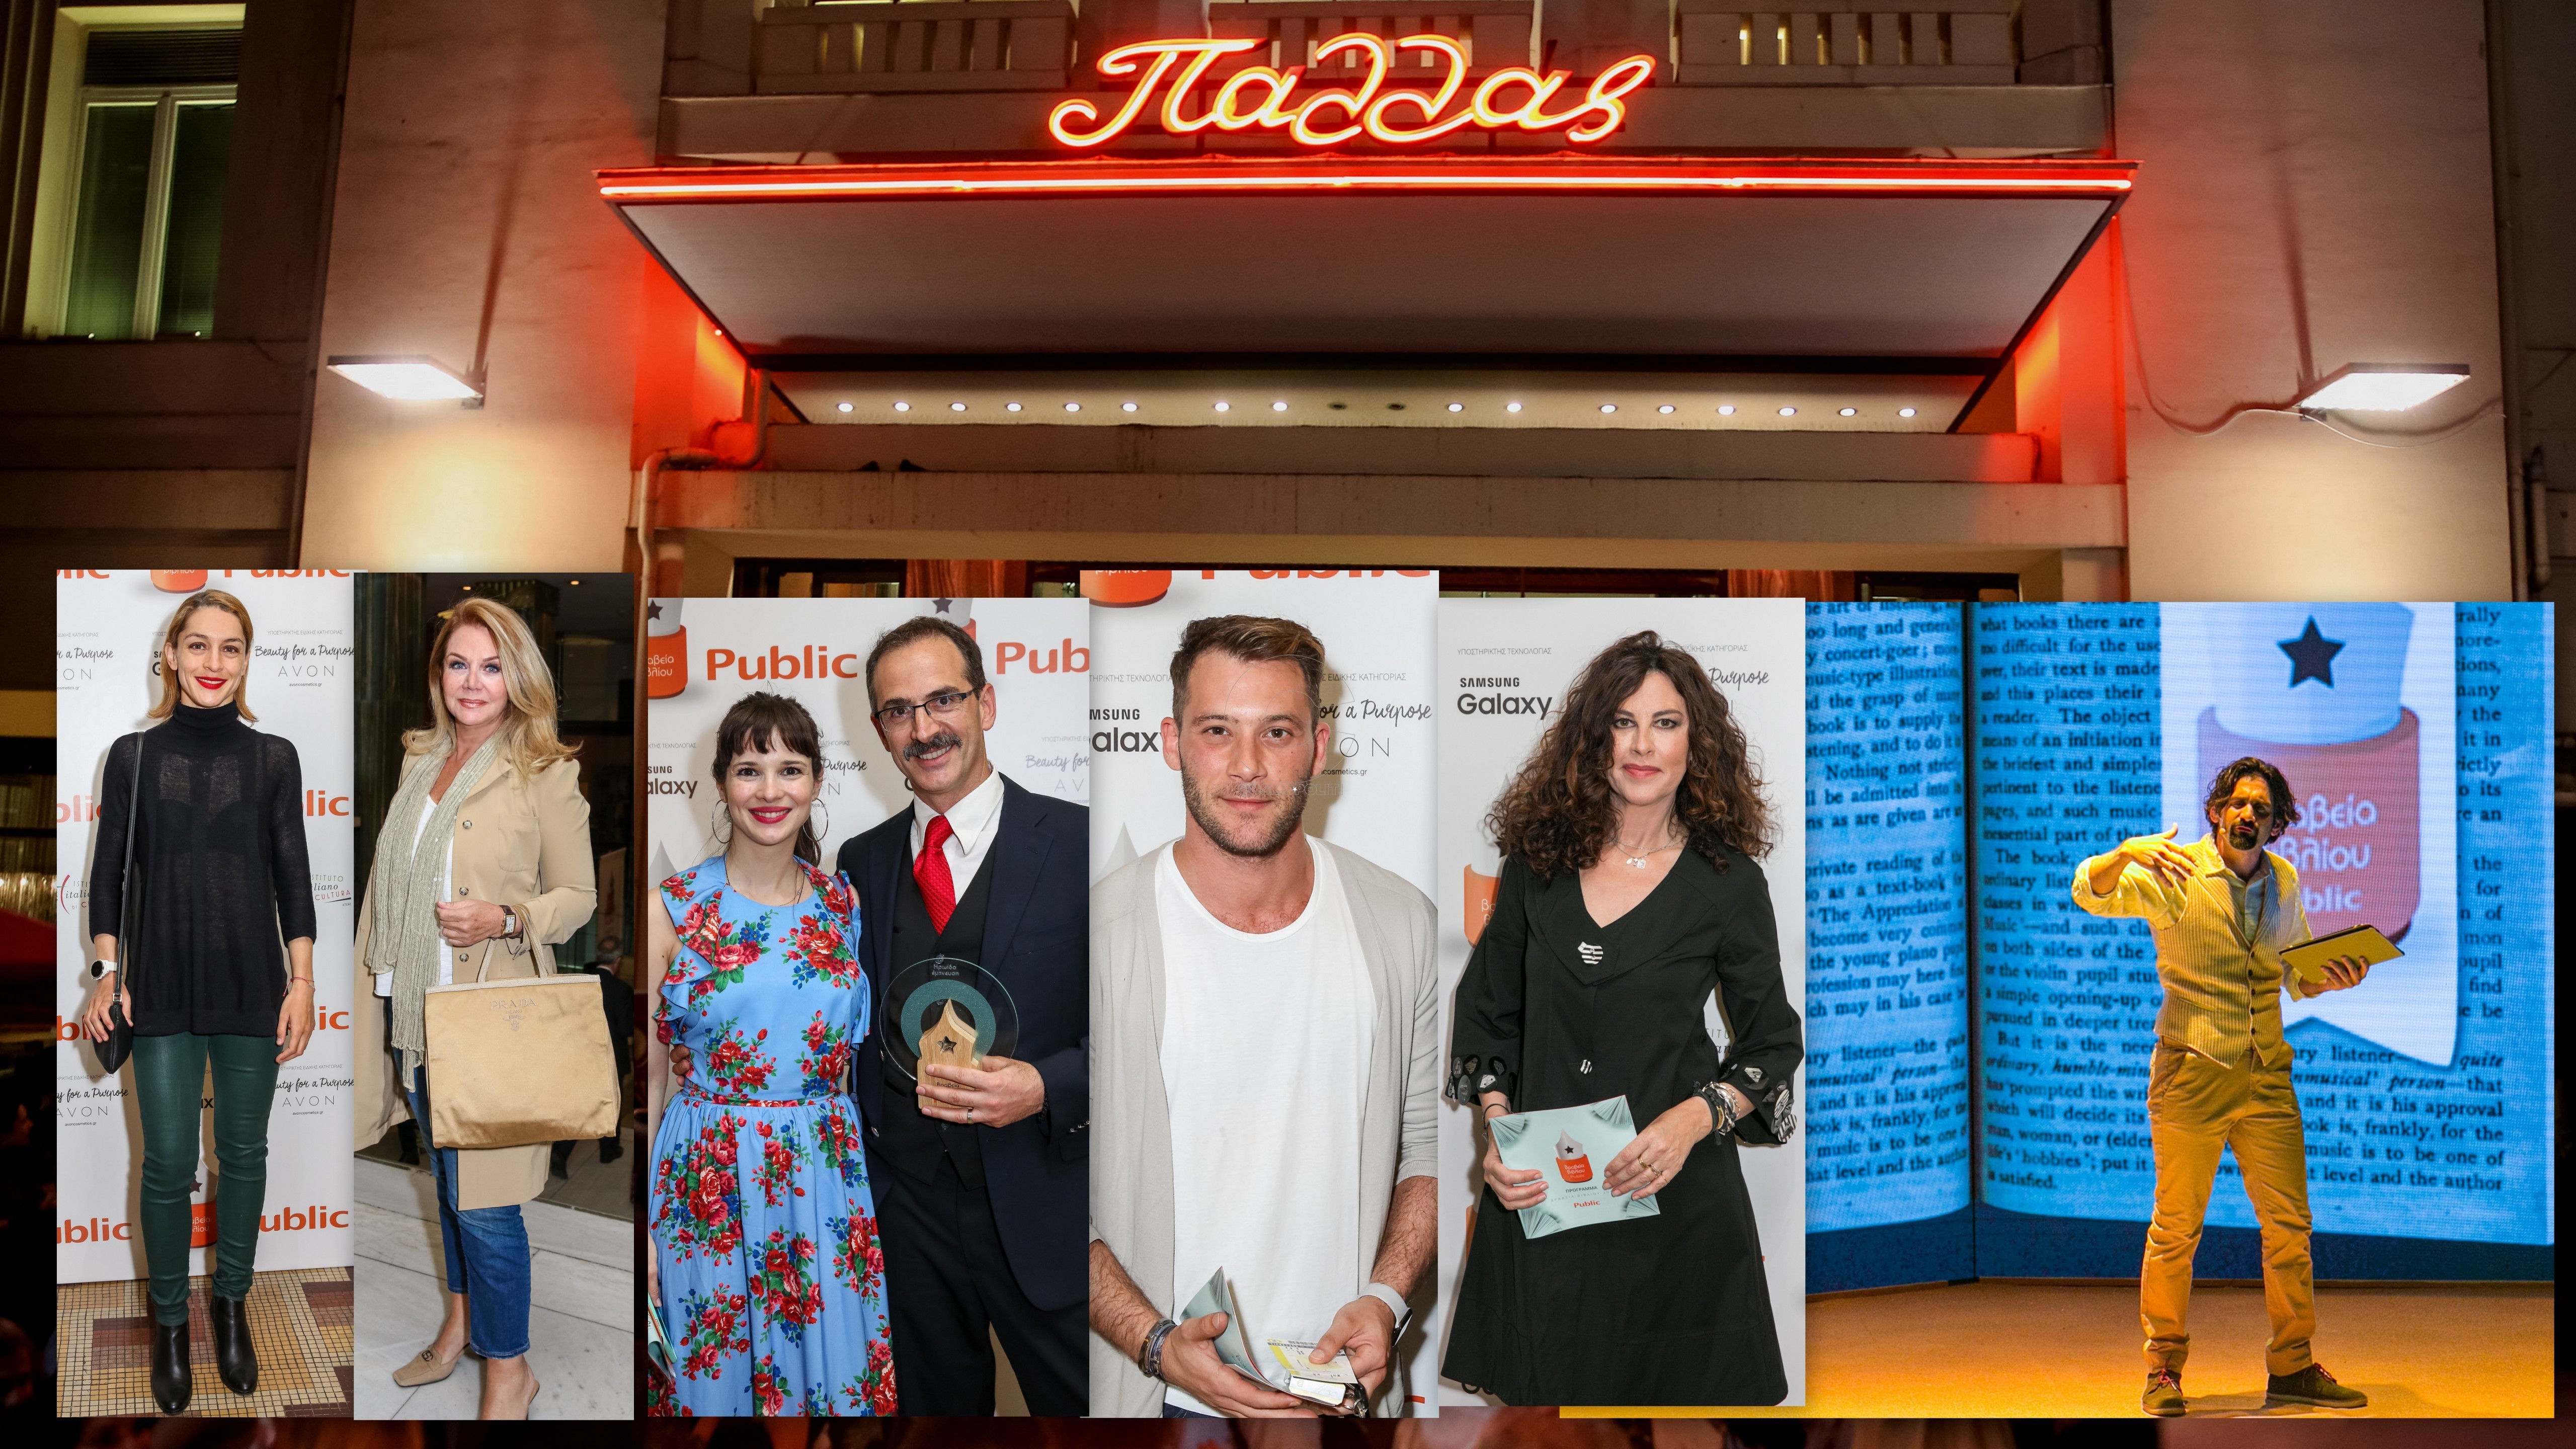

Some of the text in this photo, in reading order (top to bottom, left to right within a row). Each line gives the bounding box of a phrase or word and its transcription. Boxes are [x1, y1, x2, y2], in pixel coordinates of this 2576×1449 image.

[1833, 619, 1903, 640] long and
[2014, 615, 2144, 631] books there are
[74, 647, 114, 663] Purpose
[255, 646, 290, 660] Beauty
[292, 645, 307, 660] for
[310, 648, 316, 656] a
[2002, 638, 2125, 654] difficult for the
[278, 665, 334, 677] AVON
[707, 645, 858, 681] Public
[2013, 661, 2046, 677] their
[2053, 663, 2086, 676] text
[2094, 662, 2106, 675] is
[1328, 673, 1407, 681] ΕΙΔΙΚΗΣ ΚΑΤΗΓΟΡΙΑΣ
[1460, 677, 1520, 688] SAMSUNG
[1709, 667, 1770, 691] Purpose
[1829, 691, 1903, 710] the grasp
[2045, 686, 2144, 703] places their
[1346, 706, 1356, 718] a
[1361, 699, 1432, 727] Purpose
[1457, 693, 1553, 720] Galaxy
[1807, 712, 1943, 734] book is to supply
[2058, 708, 2150, 726] The object
[2069, 733, 2142, 747] initiation
[823, 758, 867, 776] Purpose
[1025, 755, 1070, 772] Beauty
[1826, 759, 1921, 782] Nothing not
[2003, 756, 2093, 771] briefest and
[1851, 783, 1918, 803] admitted
[1867, 852, 1922, 874] reading
[1877, 875, 1945, 896] text-book
[315, 890, 351, 901] CULTURA
[1820, 898, 1951, 924] The Appreciation
[1811, 928, 1912, 947] become very
[1810, 944, 1938, 971] the young piano
[2025, 963, 2118, 987] violin pupil
[491, 998, 537, 1009] PRADA
[1997, 988, 2141, 1008] simple opening-up
[2064, 1013, 2118, 1030] deeper
[296, 1078, 309, 1092] for
[2010, 1083, 2083, 1101] prompted
[67, 1089, 81, 1103] for
[92, 1088, 129, 1101] Purpose
[282, 1095, 335, 1107] AVON
[2029, 1105, 2144, 1123] will decide its
[2305, 1095, 2503, 1118] and it is his approval
[2340, 1121, 2503, 1141] is, frankly, for the
[2306, 1144, 2504, 1165] music is to be one of
[2324, 1167, 2502, 1190] level and the author
[1573, 1200, 1601, 1208] Public
